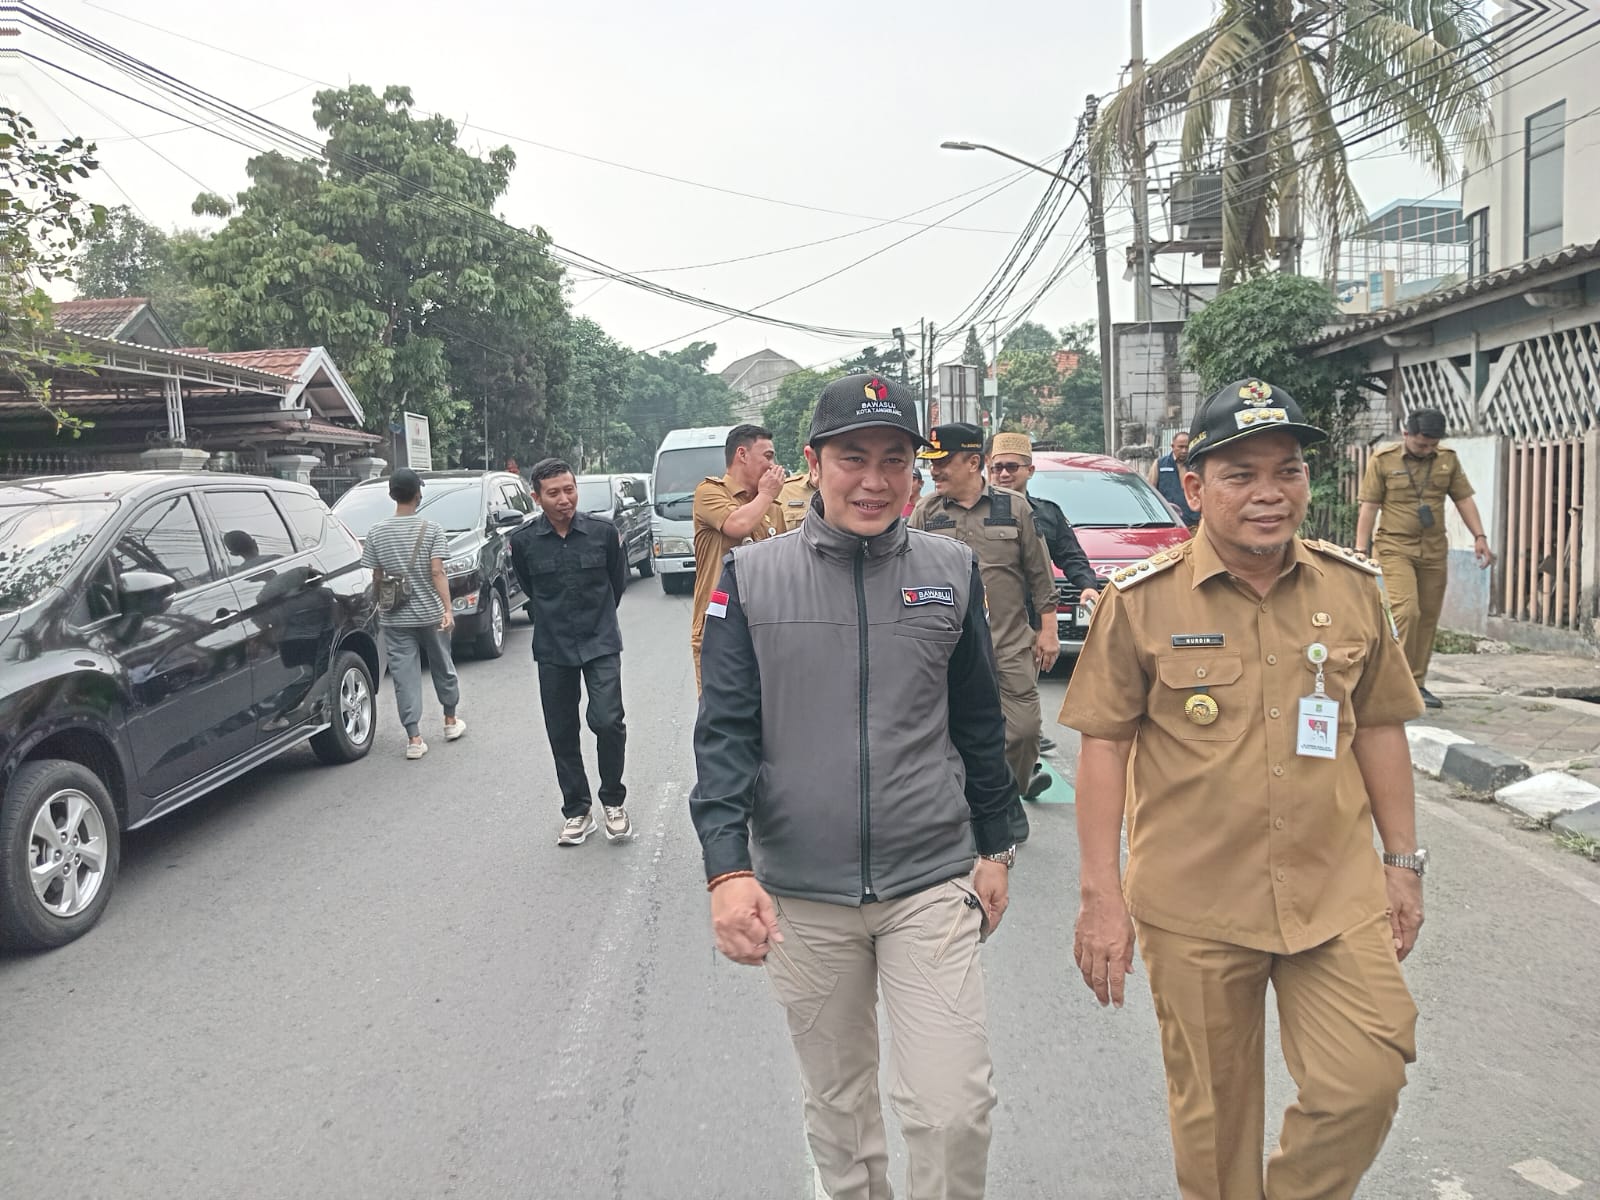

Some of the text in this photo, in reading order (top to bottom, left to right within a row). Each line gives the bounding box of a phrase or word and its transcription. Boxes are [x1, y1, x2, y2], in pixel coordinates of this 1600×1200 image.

[861, 401, 897, 409] BAWASLU
[856, 408, 871, 416] KOTA
[919, 590, 951, 600] BAWASLU
